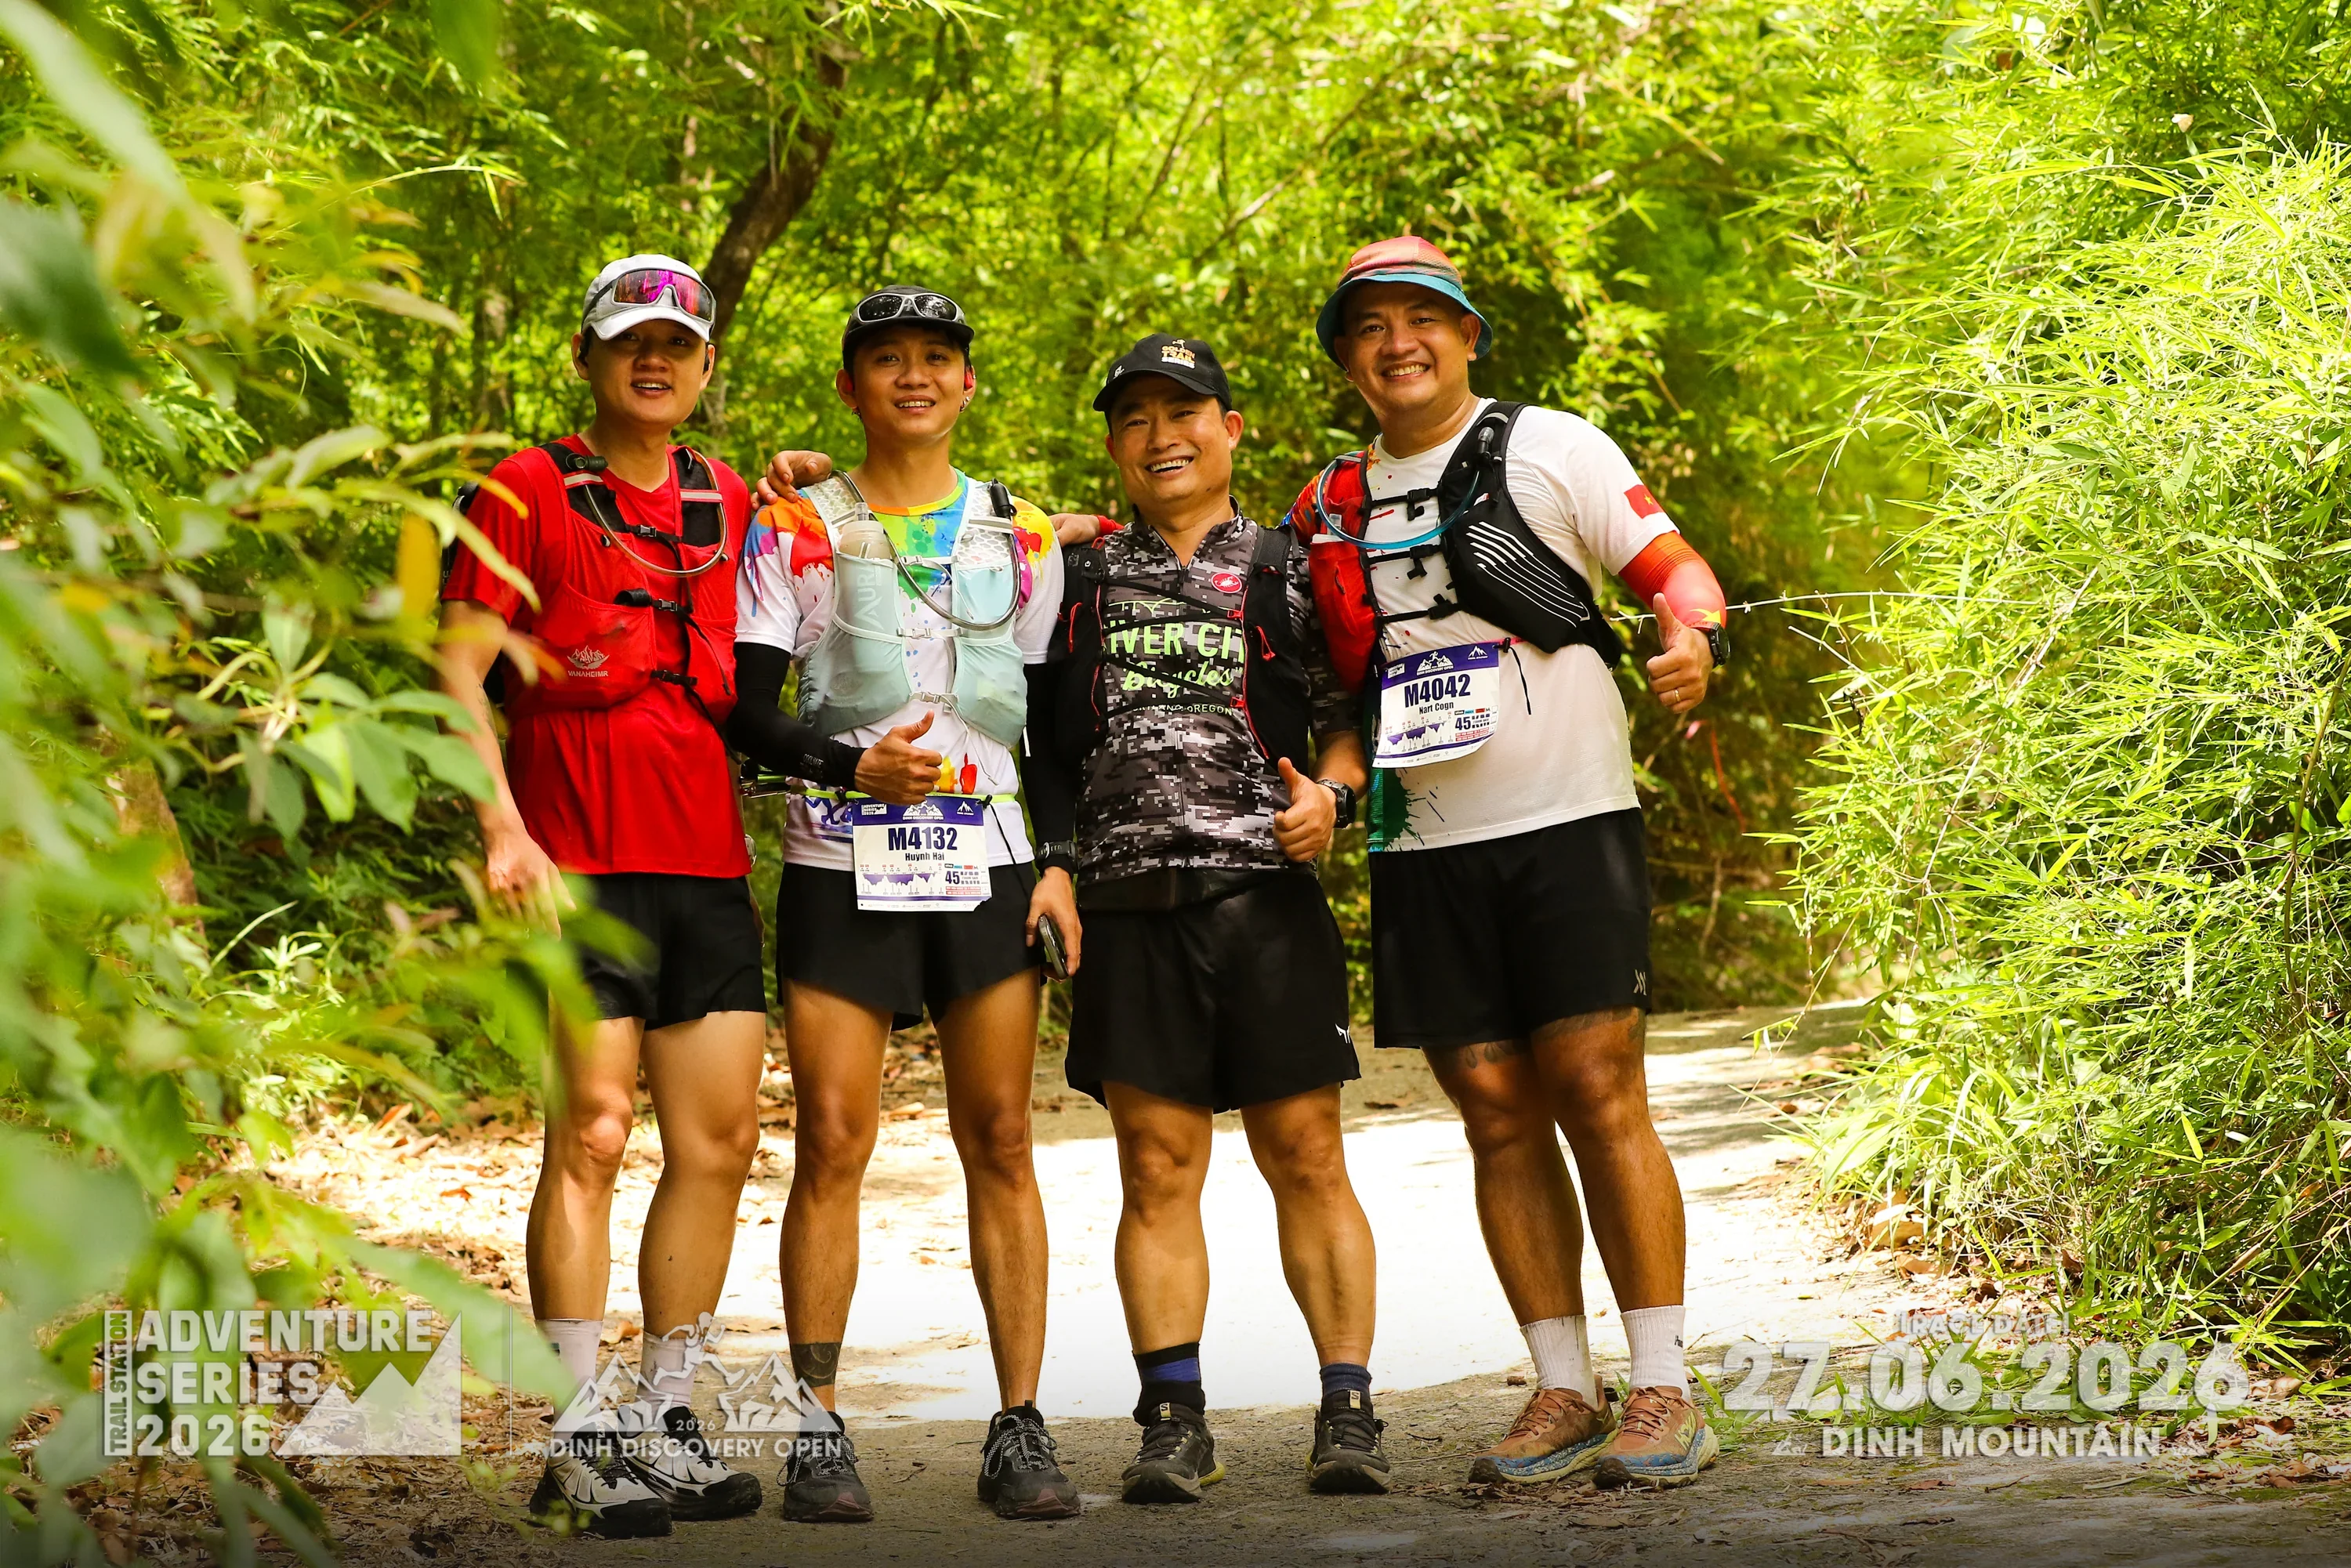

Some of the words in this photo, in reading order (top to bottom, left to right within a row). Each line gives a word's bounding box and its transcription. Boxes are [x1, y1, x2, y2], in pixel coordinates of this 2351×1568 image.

[1161, 350, 1195, 364] TRAIL
[1162, 346, 1195, 359] GOLDEN
[1103, 620, 1184, 656] IVER
[1404, 674, 1471, 708] M4042
[1419, 705, 1433, 715] Nart
[1435, 701, 1454, 712] Cogn
[888, 827, 958, 850] M4132
